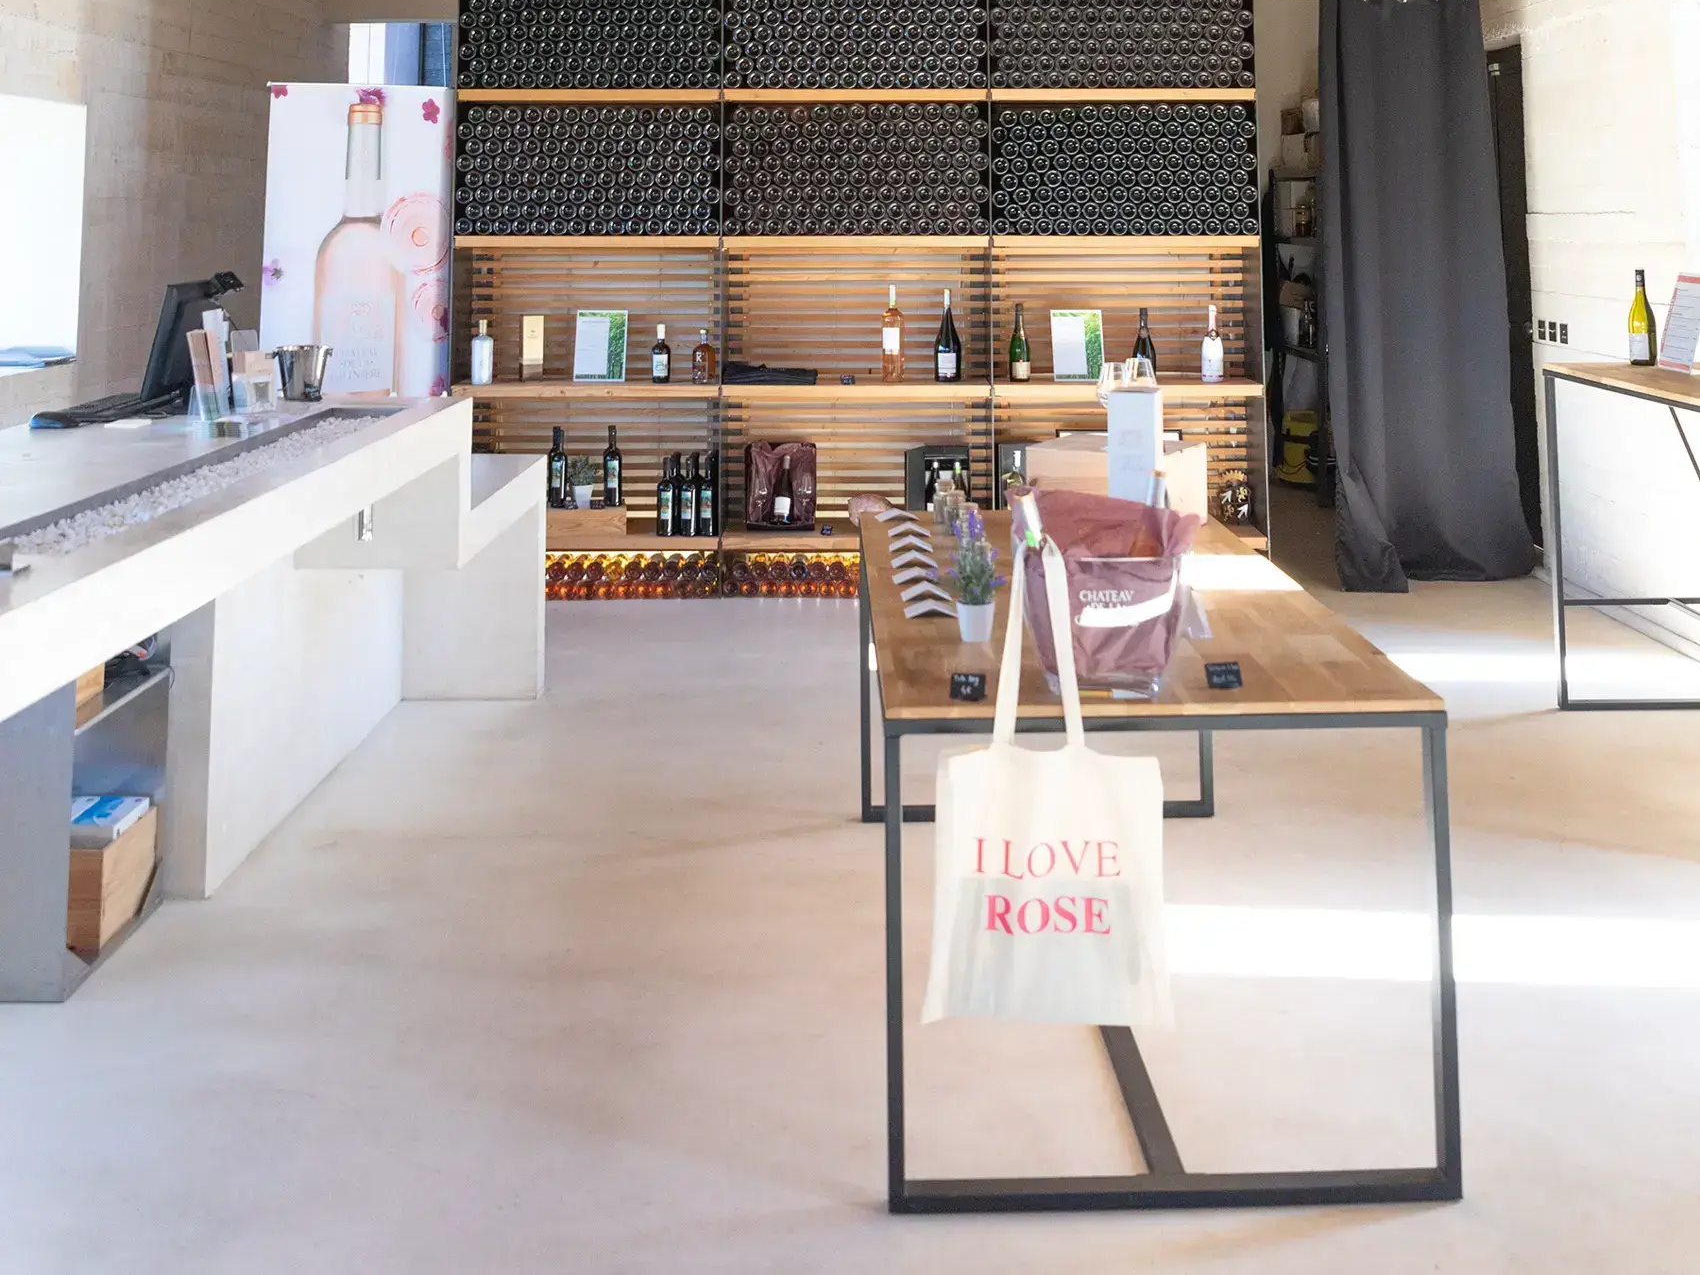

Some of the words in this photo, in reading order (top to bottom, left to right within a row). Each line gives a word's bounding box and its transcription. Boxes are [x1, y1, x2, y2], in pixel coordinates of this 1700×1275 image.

[1079, 589, 1134, 602] CHATEAV
[973, 837, 986, 873] I
[1001, 838, 1121, 879] LOVE
[984, 893, 1111, 935] ROSE
